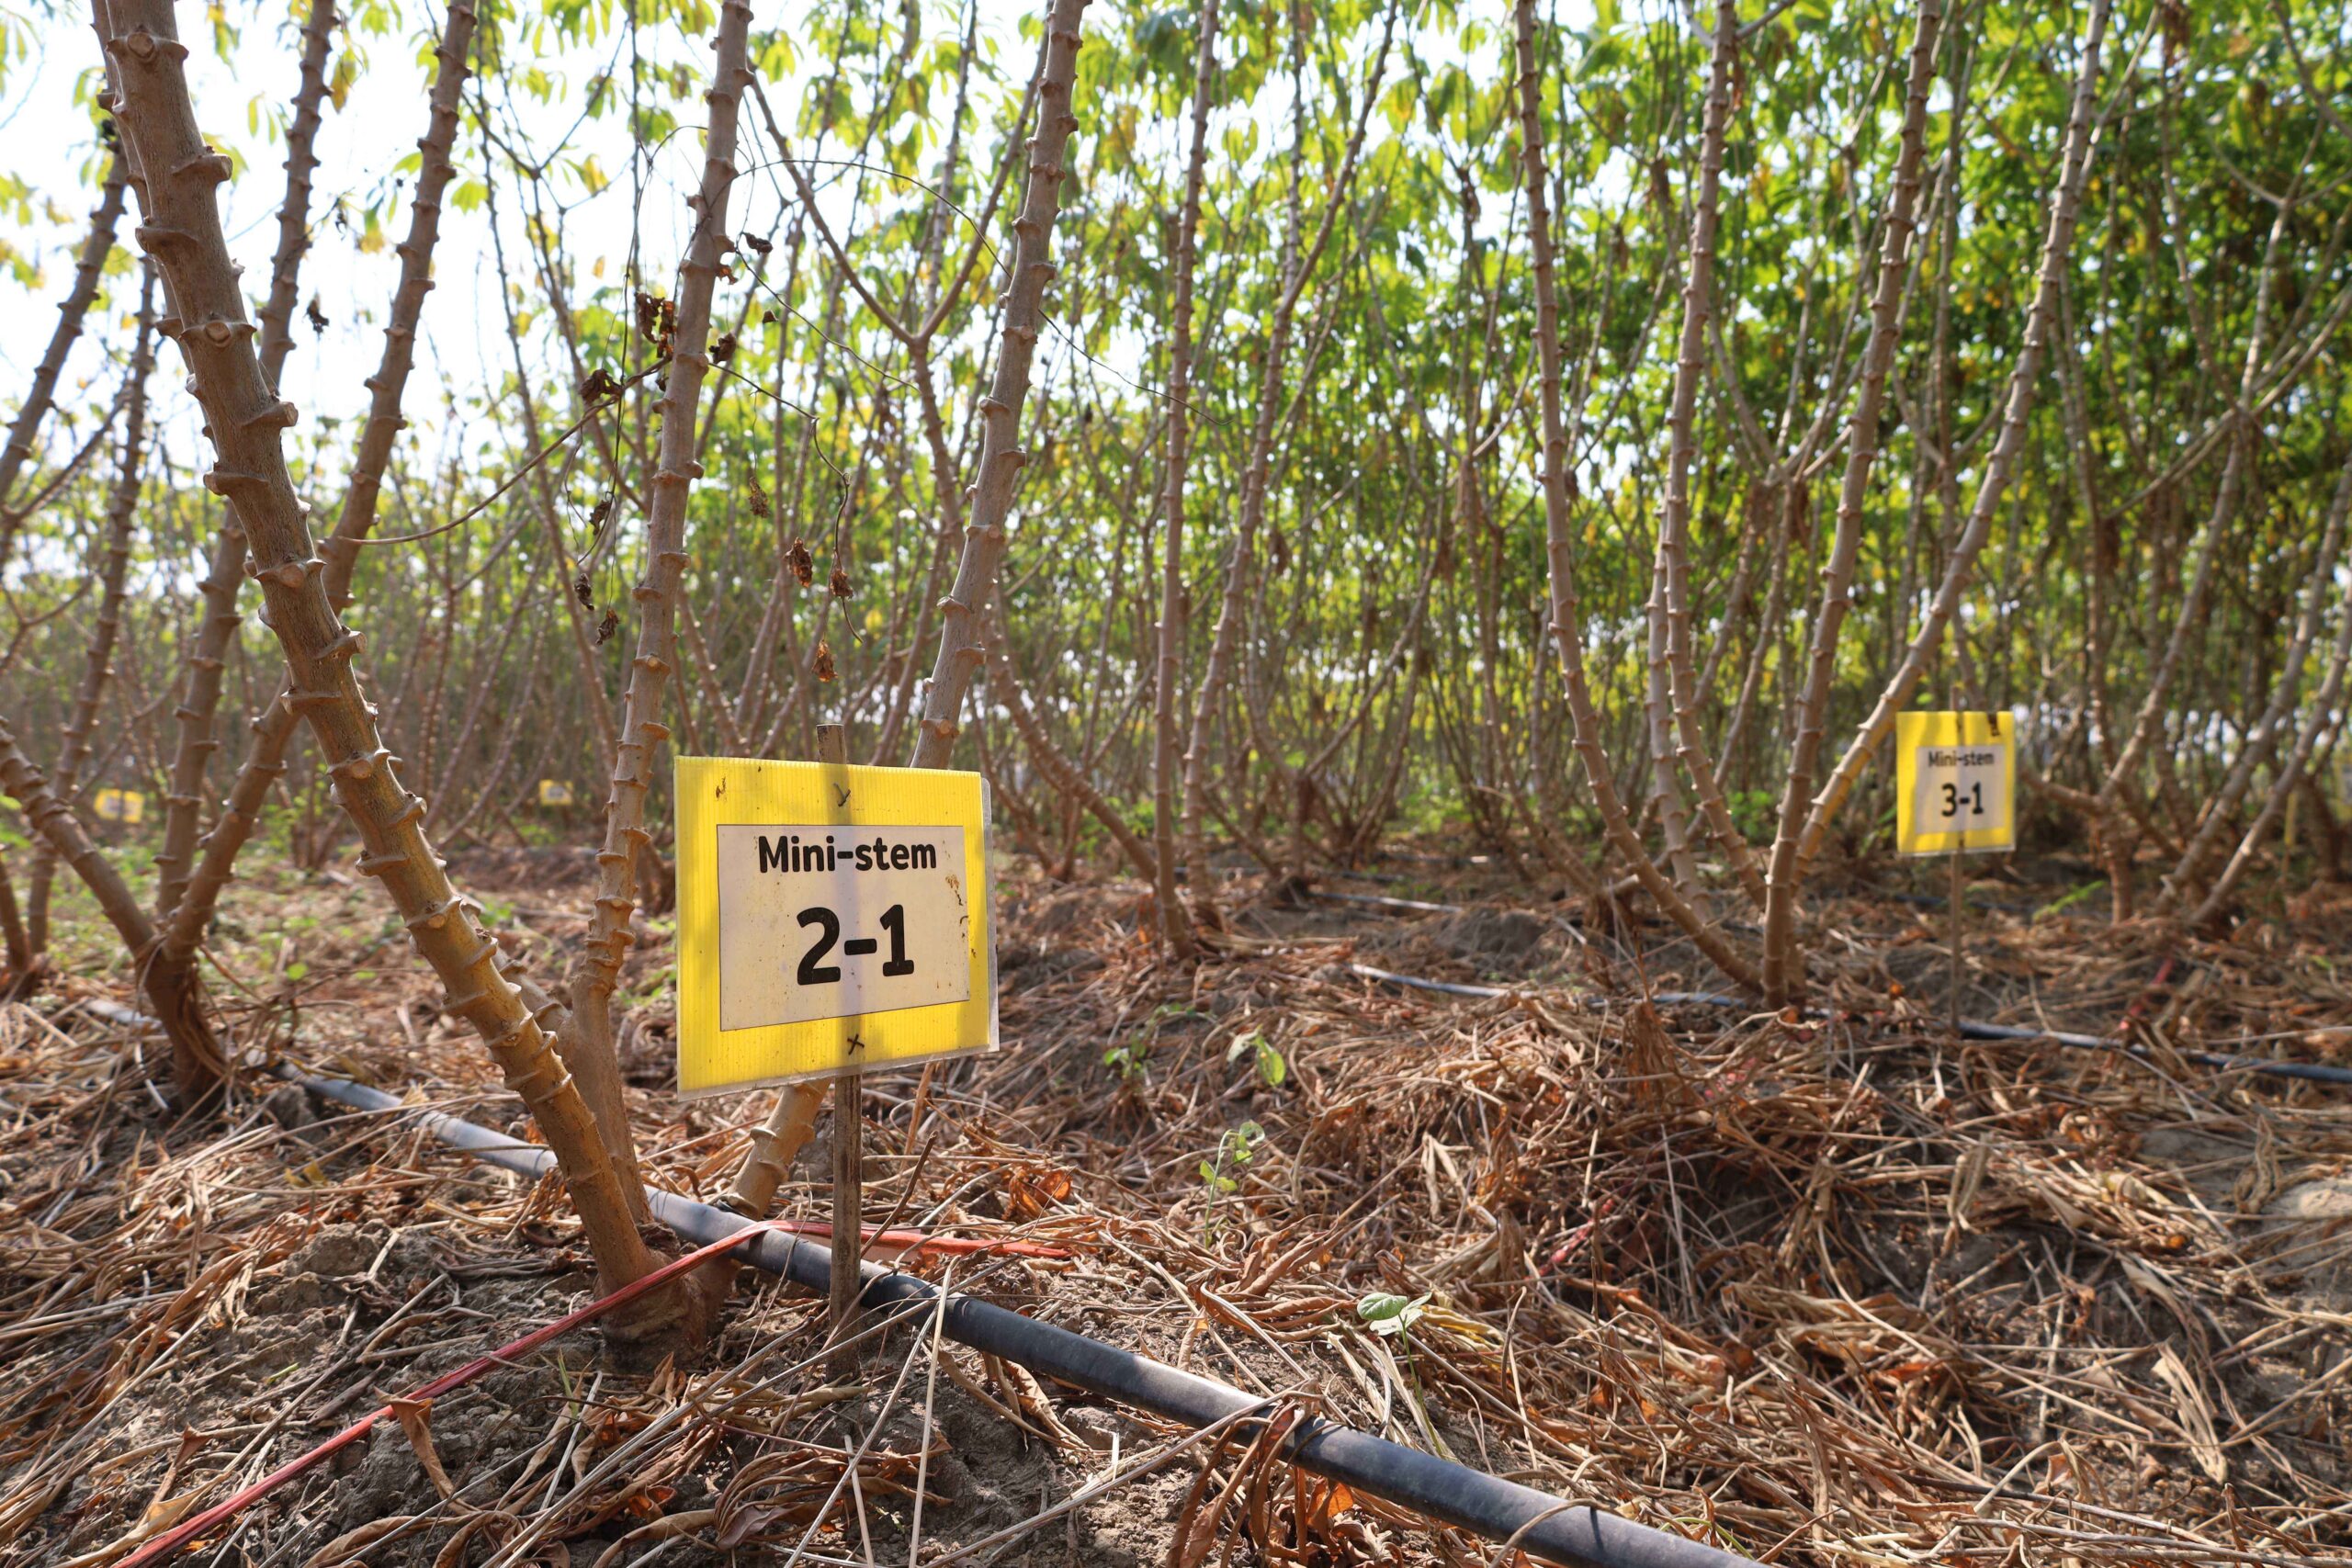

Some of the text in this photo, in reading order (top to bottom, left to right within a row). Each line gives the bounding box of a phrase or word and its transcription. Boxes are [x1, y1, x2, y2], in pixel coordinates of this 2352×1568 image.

[1928, 750, 1995, 768] Mini-stem
[1941, 781, 1984, 818] 3-1
[758, 835, 937, 874] Mini-stem
[796, 904, 915, 986] 2-1
